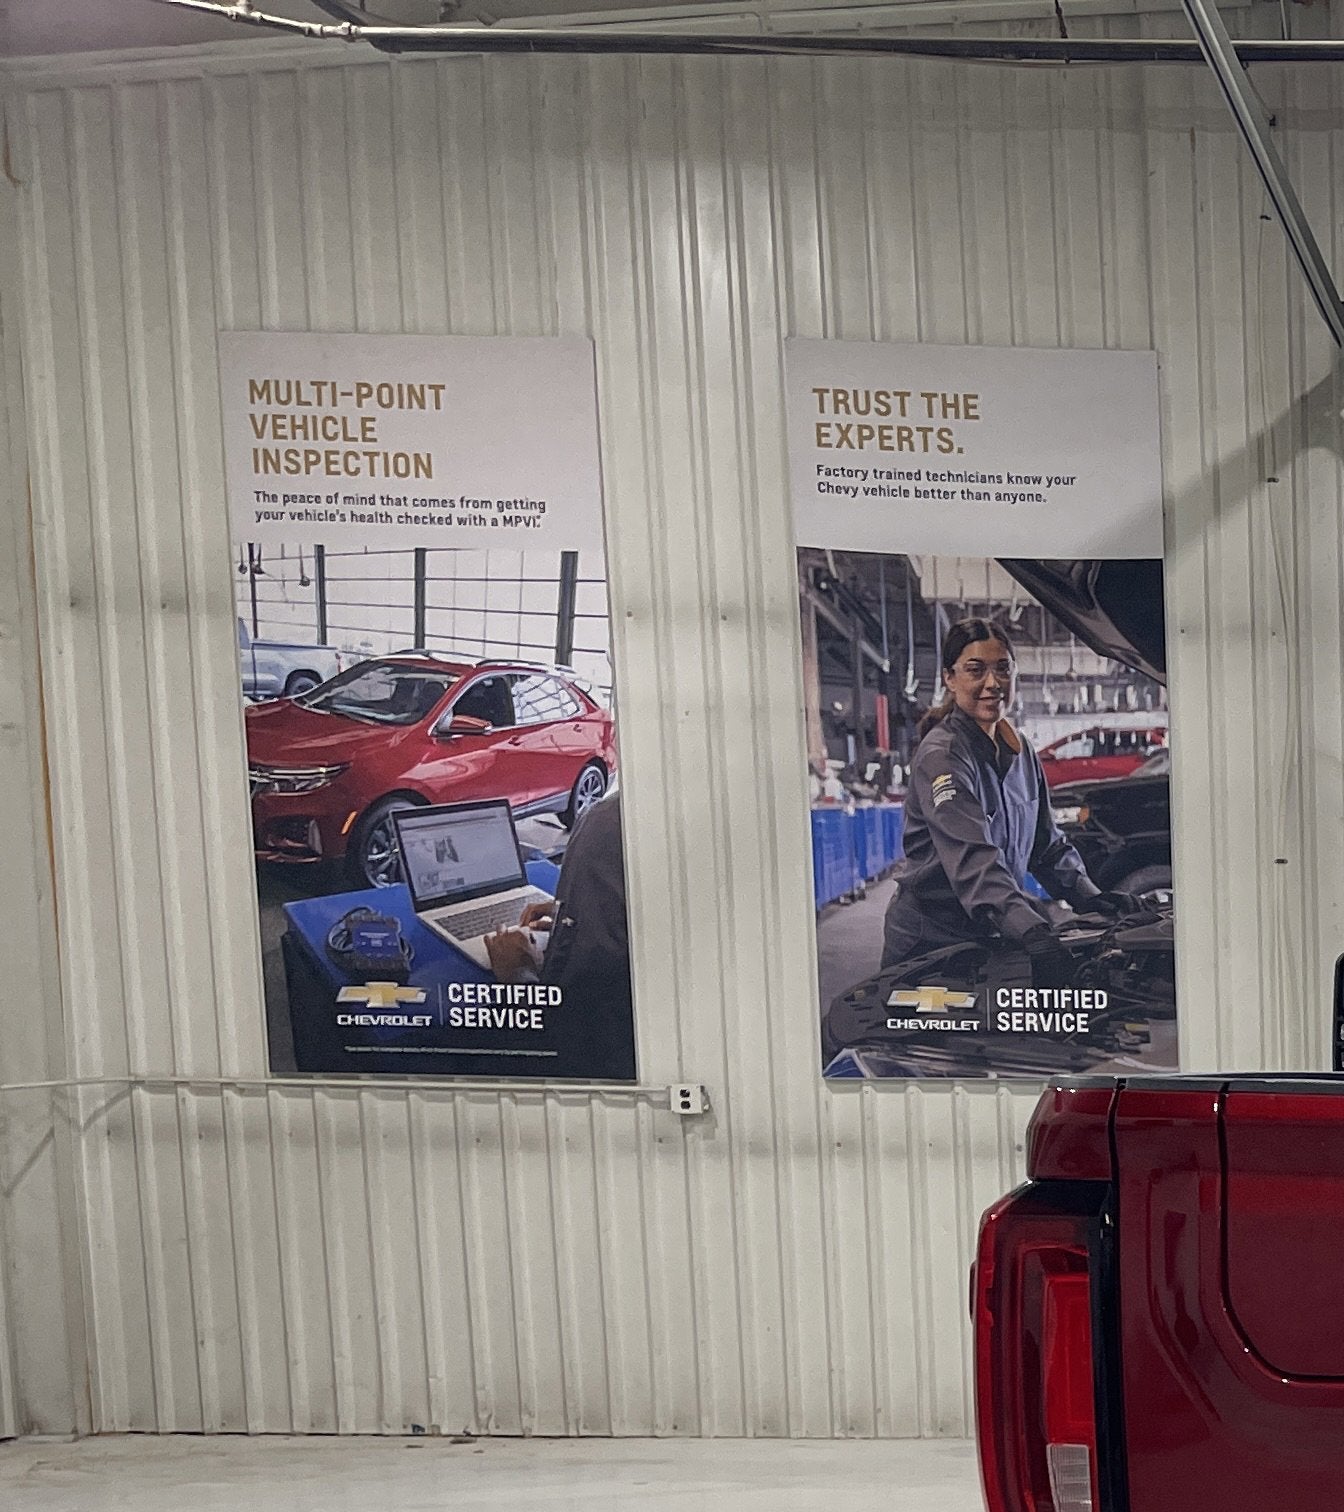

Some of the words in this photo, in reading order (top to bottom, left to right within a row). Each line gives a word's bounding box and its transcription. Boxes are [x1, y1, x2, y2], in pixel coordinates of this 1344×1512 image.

[248, 379, 446, 410] MULTI-POINT
[812, 387, 912, 418] TRUST
[920, 392, 980, 420] THE
[249, 413, 378, 443] VEHICLE
[815, 422, 964, 454] EXPERTS.
[252, 447, 434, 480] INSPECTION
[816, 464, 868, 481] Factory
[873, 468, 921, 480] trained
[925, 470, 1003, 484] technicians
[1006, 472, 1042, 485] know
[1046, 475, 1077, 488] your
[254, 490, 278, 503] The
[282, 492, 321, 506] peace
[326, 492, 339, 505] of
[343, 493, 376, 506] mind
[380, 494, 408, 507] that
[412, 497, 456, 508] comes
[460, 496, 492, 509] from
[496, 497, 546, 513] getting
[817, 481, 859, 498] Chevy
[862, 484, 910, 498] vehicle
[914, 485, 957, 500] better
[961, 488, 991, 501] than
[994, 491, 1048, 505] anyone.
[255, 510, 285, 523] your
[289, 509, 347, 522] vehicle's
[350, 510, 393, 524] health
[397, 512, 452, 525] checked
[457, 513, 487, 526] with
[490, 517, 498, 527] a
[447, 983, 563, 1006] CERTIFIED
[996, 988, 1108, 1010] CERTIFIED
[336, 1014, 433, 1027] CHEVROLET
[449, 1007, 544, 1029] SERVICE
[886, 1018, 980, 1032] CHEVROLET
[996, 1012, 1089, 1033] SERVICE
